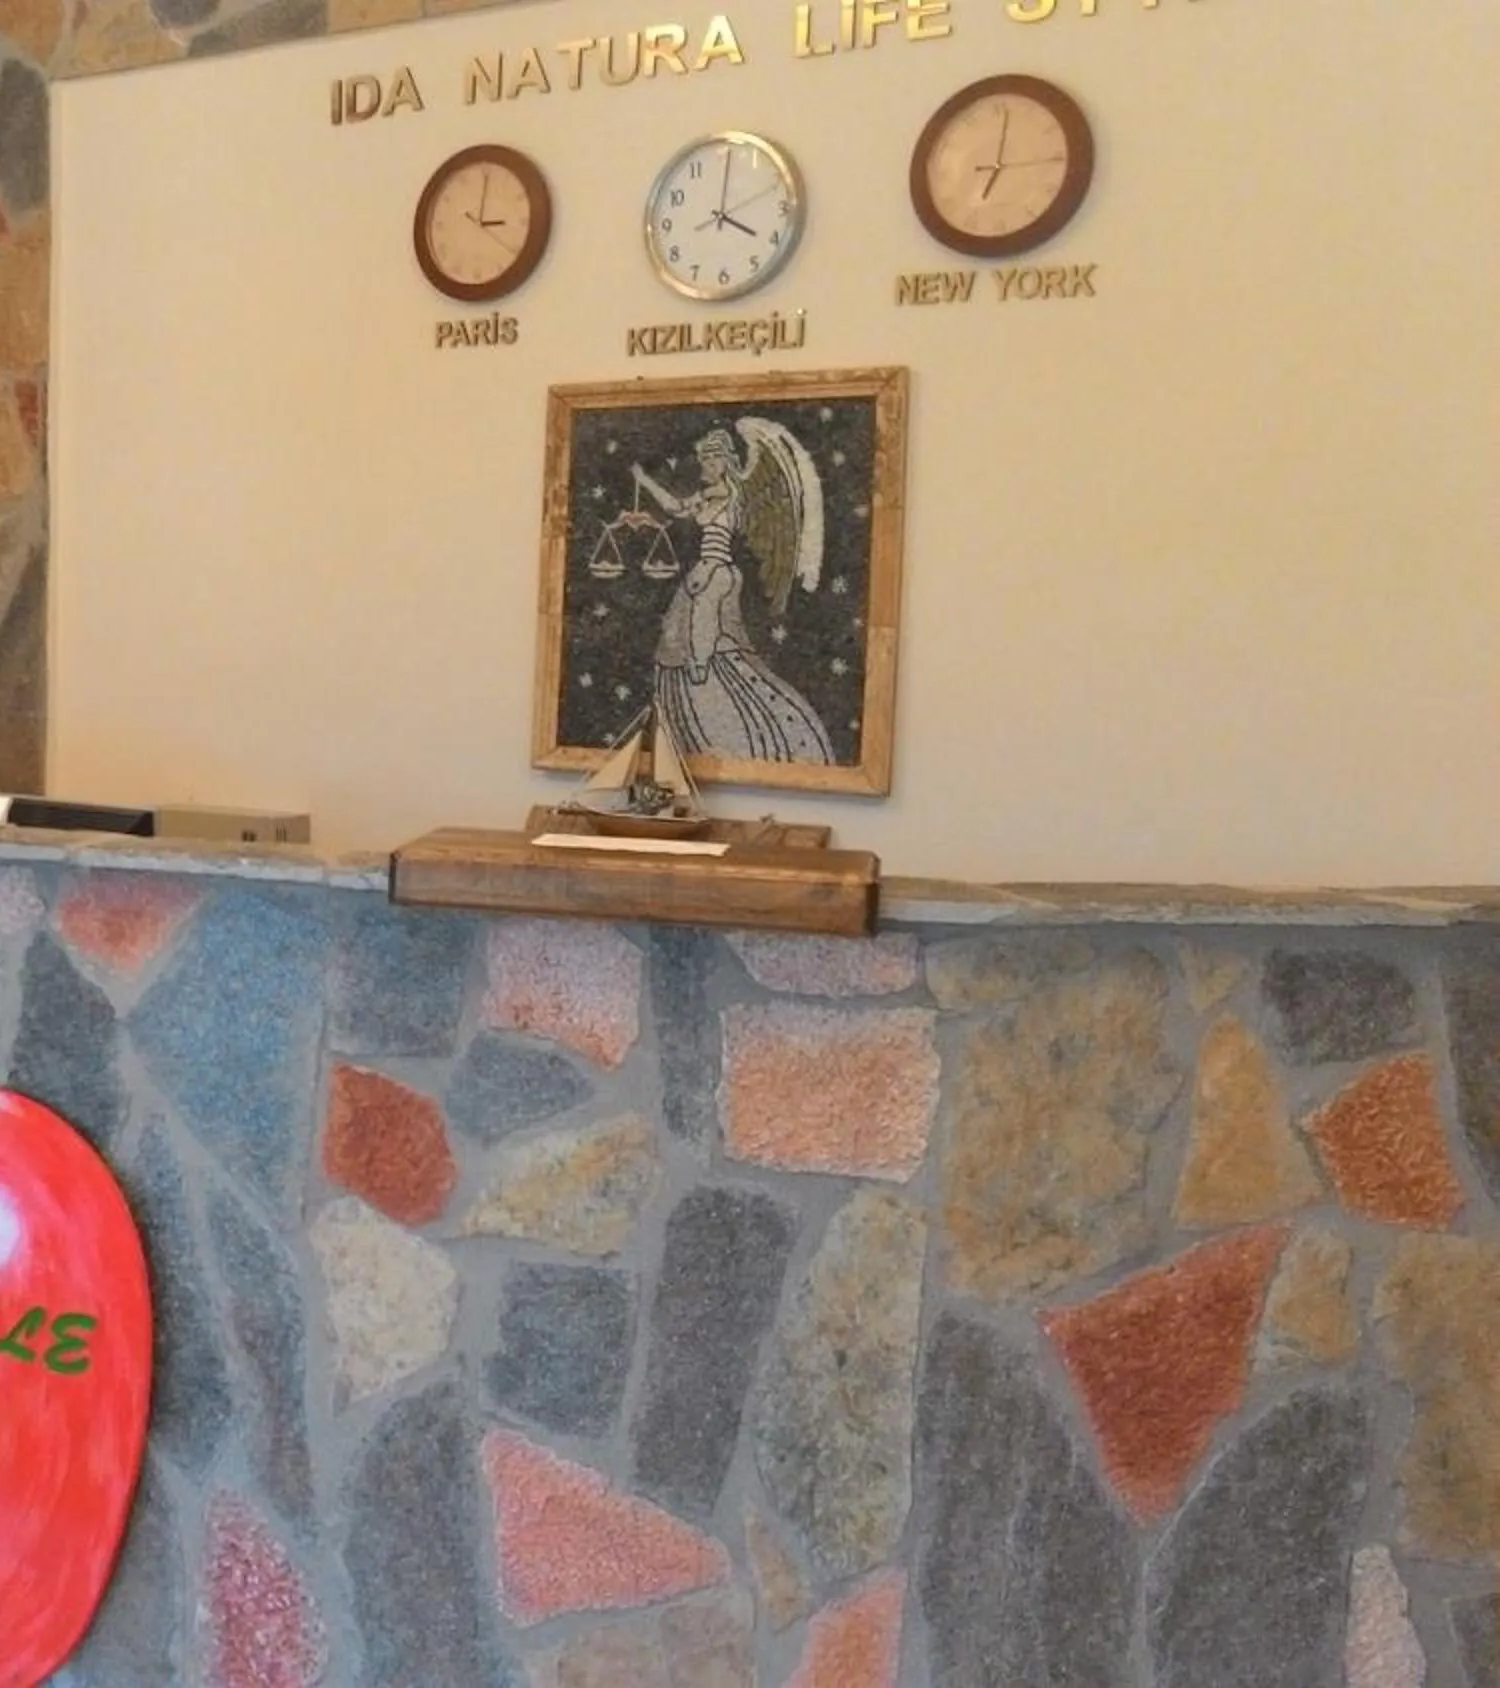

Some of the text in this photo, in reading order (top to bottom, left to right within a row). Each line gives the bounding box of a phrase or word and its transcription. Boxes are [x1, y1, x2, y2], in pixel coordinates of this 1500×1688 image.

[329, 64, 425, 126] IDA
[463, 14, 745, 106] NATURA
[895, 263, 1099, 306] NEW YORK
[435, 311, 519, 349] PARİS
[627, 309, 806, 357] KIZILKEÇİLİ
